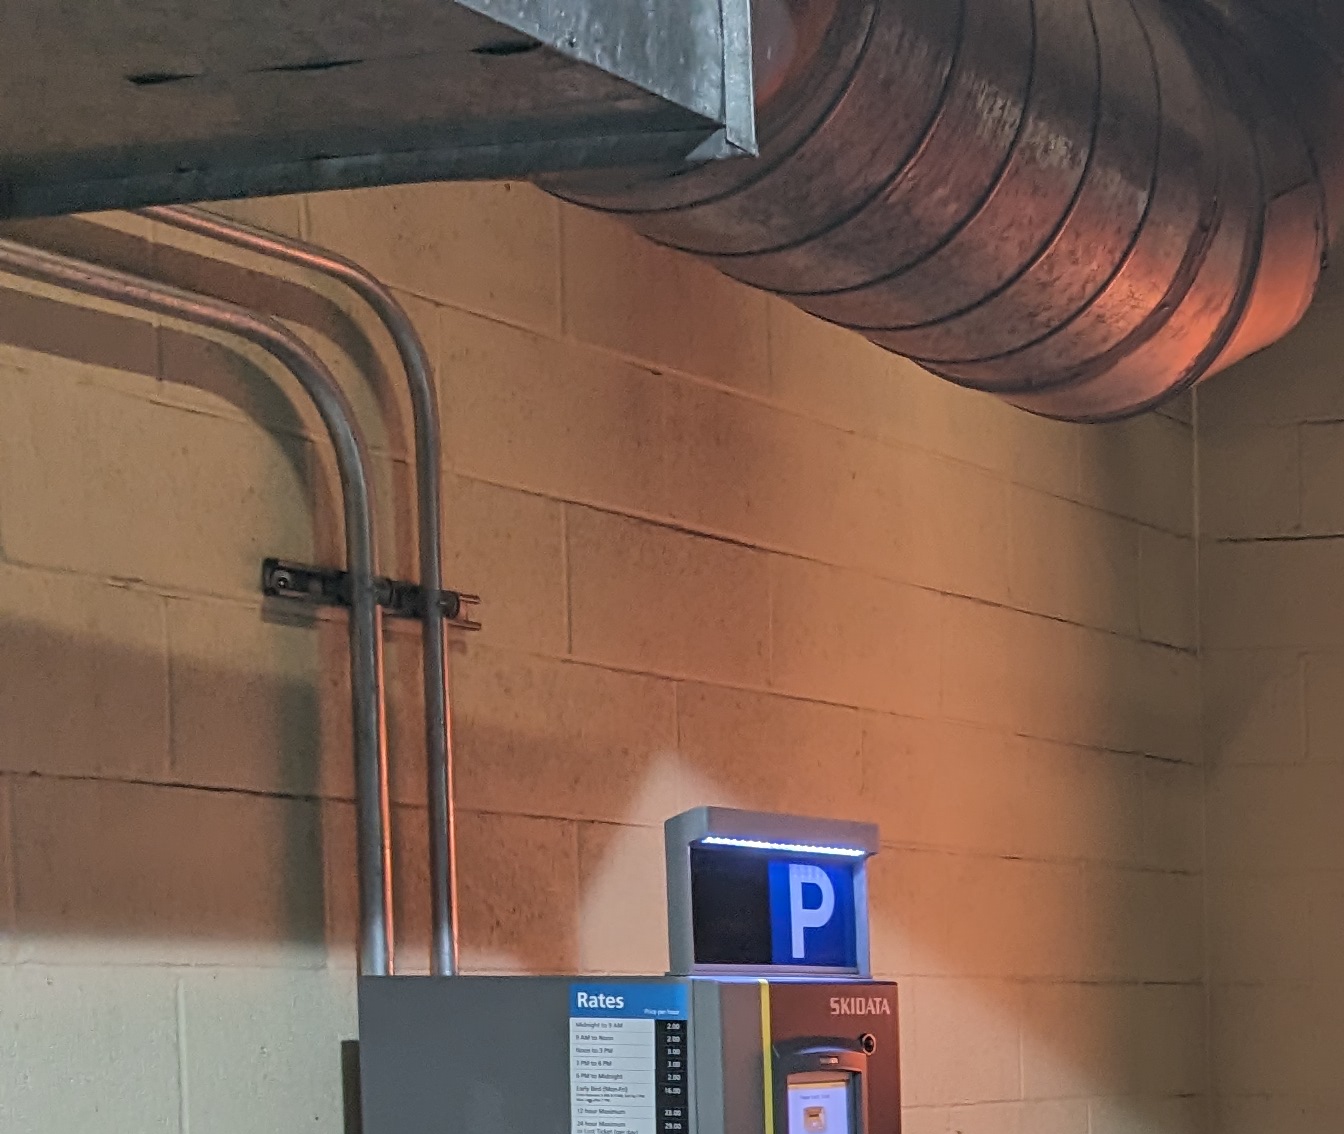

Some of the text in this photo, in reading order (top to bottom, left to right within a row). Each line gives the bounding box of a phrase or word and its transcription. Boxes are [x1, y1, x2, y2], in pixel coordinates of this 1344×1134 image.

[789, 864, 835, 958] P
[577, 992, 624, 1008] Rates
[830, 998, 890, 1015] SKIDATA
